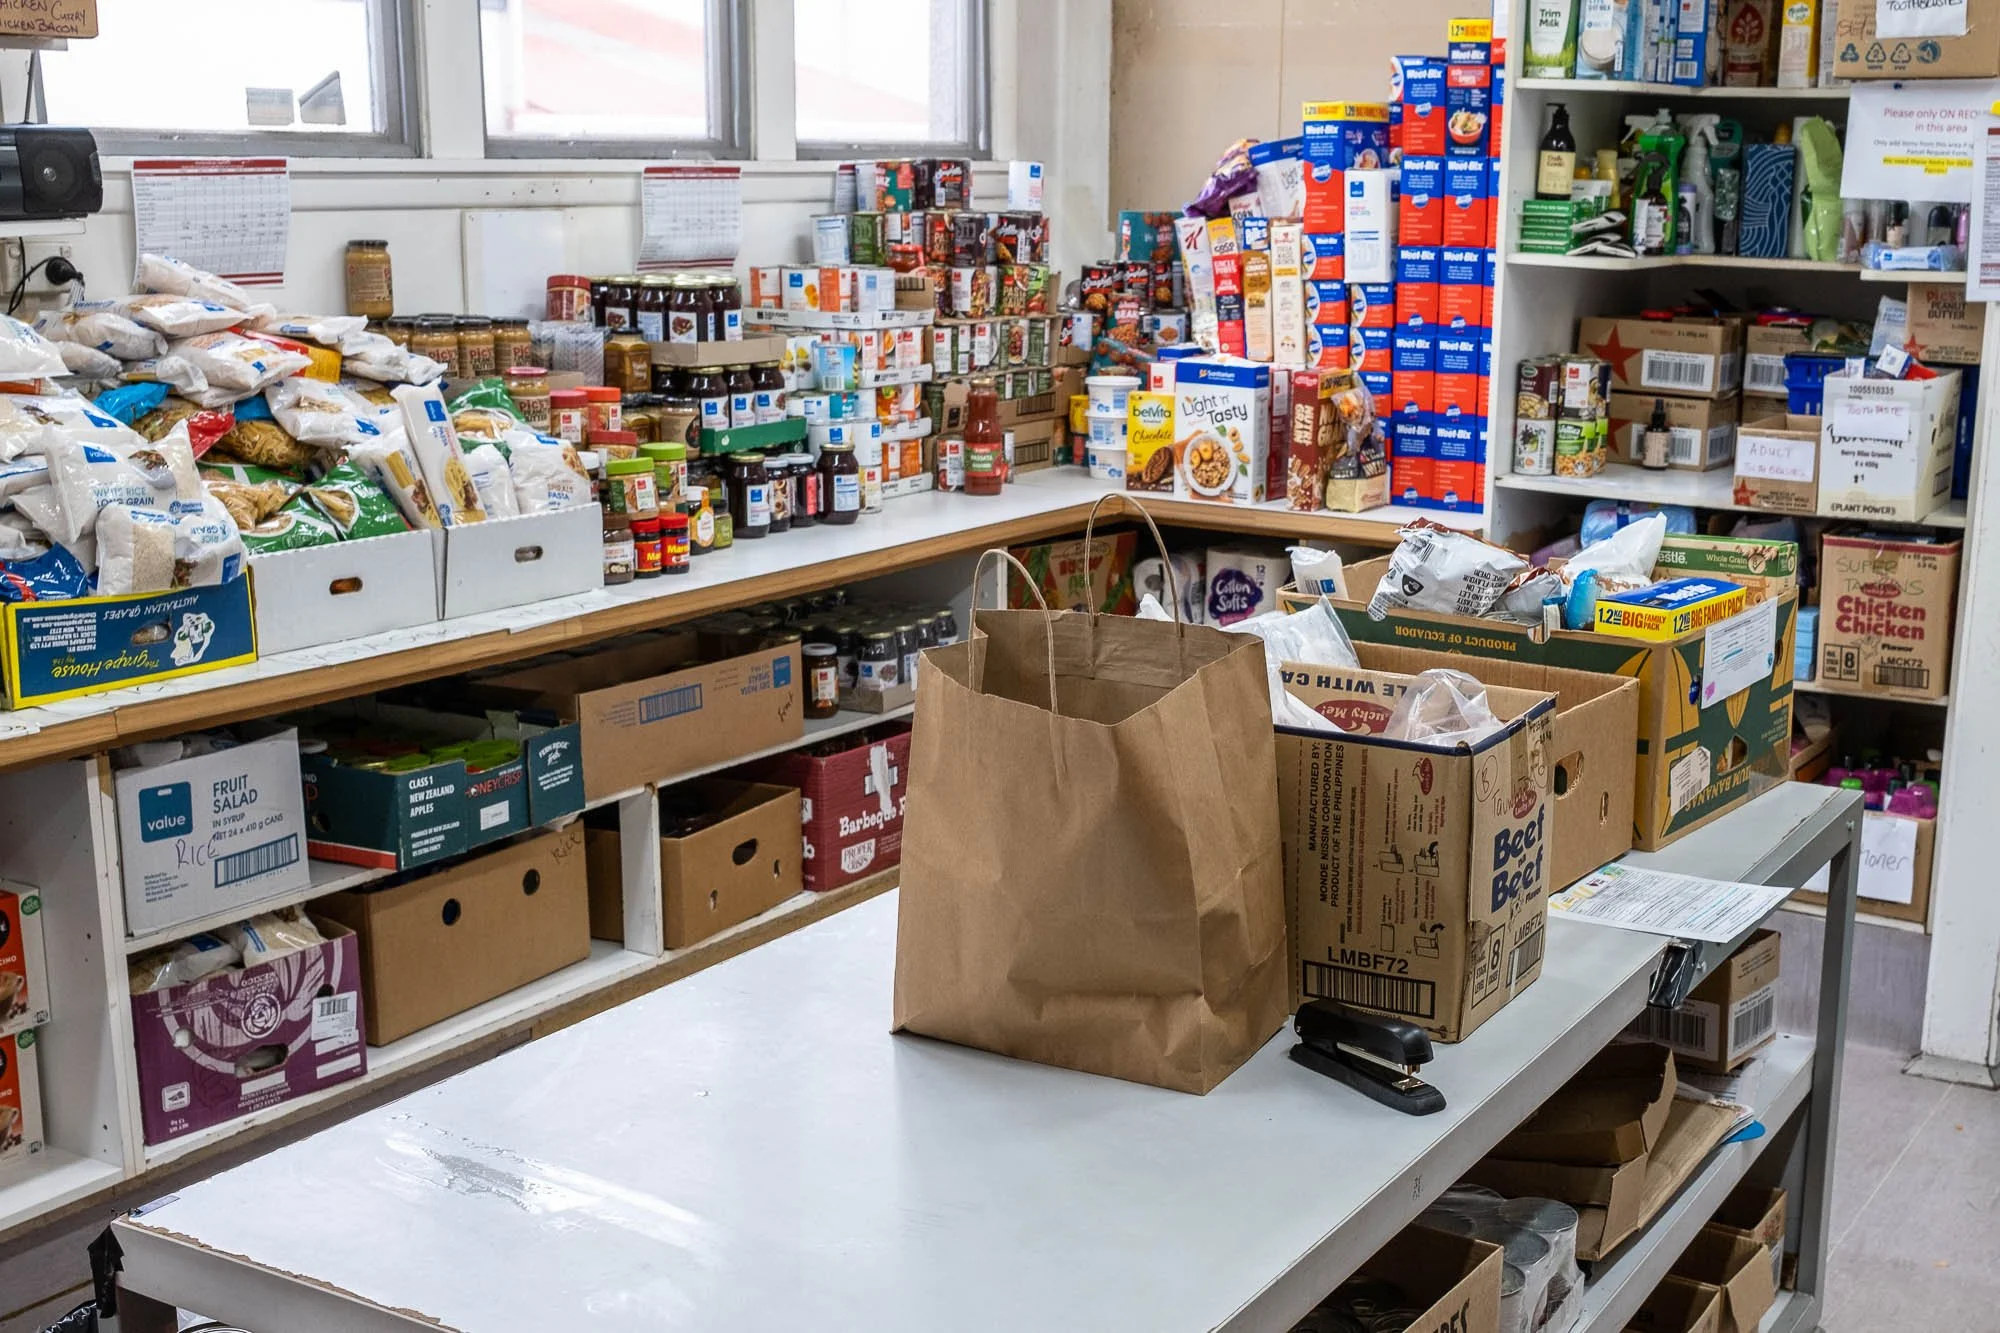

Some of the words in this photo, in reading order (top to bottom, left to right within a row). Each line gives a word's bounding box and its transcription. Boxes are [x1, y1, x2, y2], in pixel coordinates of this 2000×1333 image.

[1540, 8, 1562, 18] Trim
[35, 19, 78, 34] BACON
[1539, 17, 1560, 28] Milk
[1884, 107, 1915, 118] Please
[1916, 108, 1938, 119] only
[1940, 109, 1955, 119] ON
[1915, 123, 1924, 132] in
[1926, 123, 1944, 132] this
[1946, 124, 1968, 132] area
[1186, 226, 1203, 250] K
[1931, 300, 1967, 310] PEANUT
[1928, 310, 1965, 320] BUTTER
[1133, 404, 1172, 418] belVita
[1182, 394, 1218, 417] Light
[1207, 404, 1248, 425] Tasty
[1132, 430, 1173, 444] Chocolate
[1841, 450, 1856, 458] Berry
[1871, 451, 1893, 459] Granola
[125, 486, 146, 497] RICE
[548, 492, 570, 501] PASTA
[126, 497, 154, 506] GRAIN
[1706, 554, 1728, 563] Whole
[1729, 555, 1748, 564] Grain
[1836, 557, 1898, 574] SUPER
[1256, 564, 1265, 573] 12
[1215, 579, 1251, 597] Cotton
[1463, 575, 1489, 588] FLAVOUR
[103, 605, 141, 620] GRAPES
[145, 595, 198, 615] AUSTRALIAN
[1216, 595, 1249, 613] Softs
[1690, 610, 1703, 629] BIG
[1704, 600, 1727, 625] FAMILY
[1727, 595, 1745, 616] PACK
[1837, 595, 1926, 621] Chicken
[1622, 612, 1644, 629] BIG
[1644, 613, 1666, 623] FAMILY
[1644, 622, 1660, 631] PACK
[1836, 615, 1925, 640] Chicken
[1395, 625, 1444, 641] ECUADOR
[1447, 633, 1461, 643] OF
[1464, 636, 1517, 652] PRODUCT
[77, 644, 96, 652] PACKED
[1881, 643, 1914, 652] Flavor
[104, 649, 148, 670] Grape
[146, 659, 159, 670] The
[1844, 652, 1854, 669] 8
[1881, 656, 1923, 668] LMCK72
[51, 661, 102, 680] House
[1317, 675, 1374, 695] WITH
[1320, 705, 1348, 720] Me!
[1311, 742, 1321, 759] BY:
[213, 774, 248, 797] FRUIT
[409, 776, 429, 790] CLASS
[429, 775, 433, 785] 1
[1321, 742, 1332, 827] CORPORATION
[1333, 744, 1344, 811] PHILIPPINES
[213, 789, 258, 814] SALAD
[410, 791, 425, 804] NEW
[426, 784, 455, 800] ZEALAND
[410, 803, 434, 818] APPLES
[1308, 761, 1321, 851] MANUFACTURED
[147, 814, 186, 832] value
[212, 819, 221, 828] IN
[223, 812, 246, 826] SYRUP
[213, 831, 227, 842] NET
[228, 827, 238, 838] 24
[245, 823, 256, 833] 410
[264, 813, 284, 827] CANS
[839, 806, 897, 838] Barbeque
[1332, 814, 1341, 835] THE
[1320, 829, 1330, 860] NISSIN
[1331, 838, 1341, 853] OF
[1493, 804, 1545, 871] Beef
[175, 838, 219, 869] RICE
[844, 841, 874, 862] PROPER
[1518, 853, 1527, 869] na
[1319, 863, 1329, 902] MONDE
[1331, 856, 1341, 907] PRODUCT
[1491, 844, 1544, 914] Beef
[1525, 887, 1542, 904] Flavor
[1513, 911, 1544, 946] LMBF72
[1327, 946, 1409, 975] LMBF72
[1490, 938, 1500, 971] 8
[1476, 965, 1487, 980] STACK
[264, 1096, 281, 1105] CLASS
